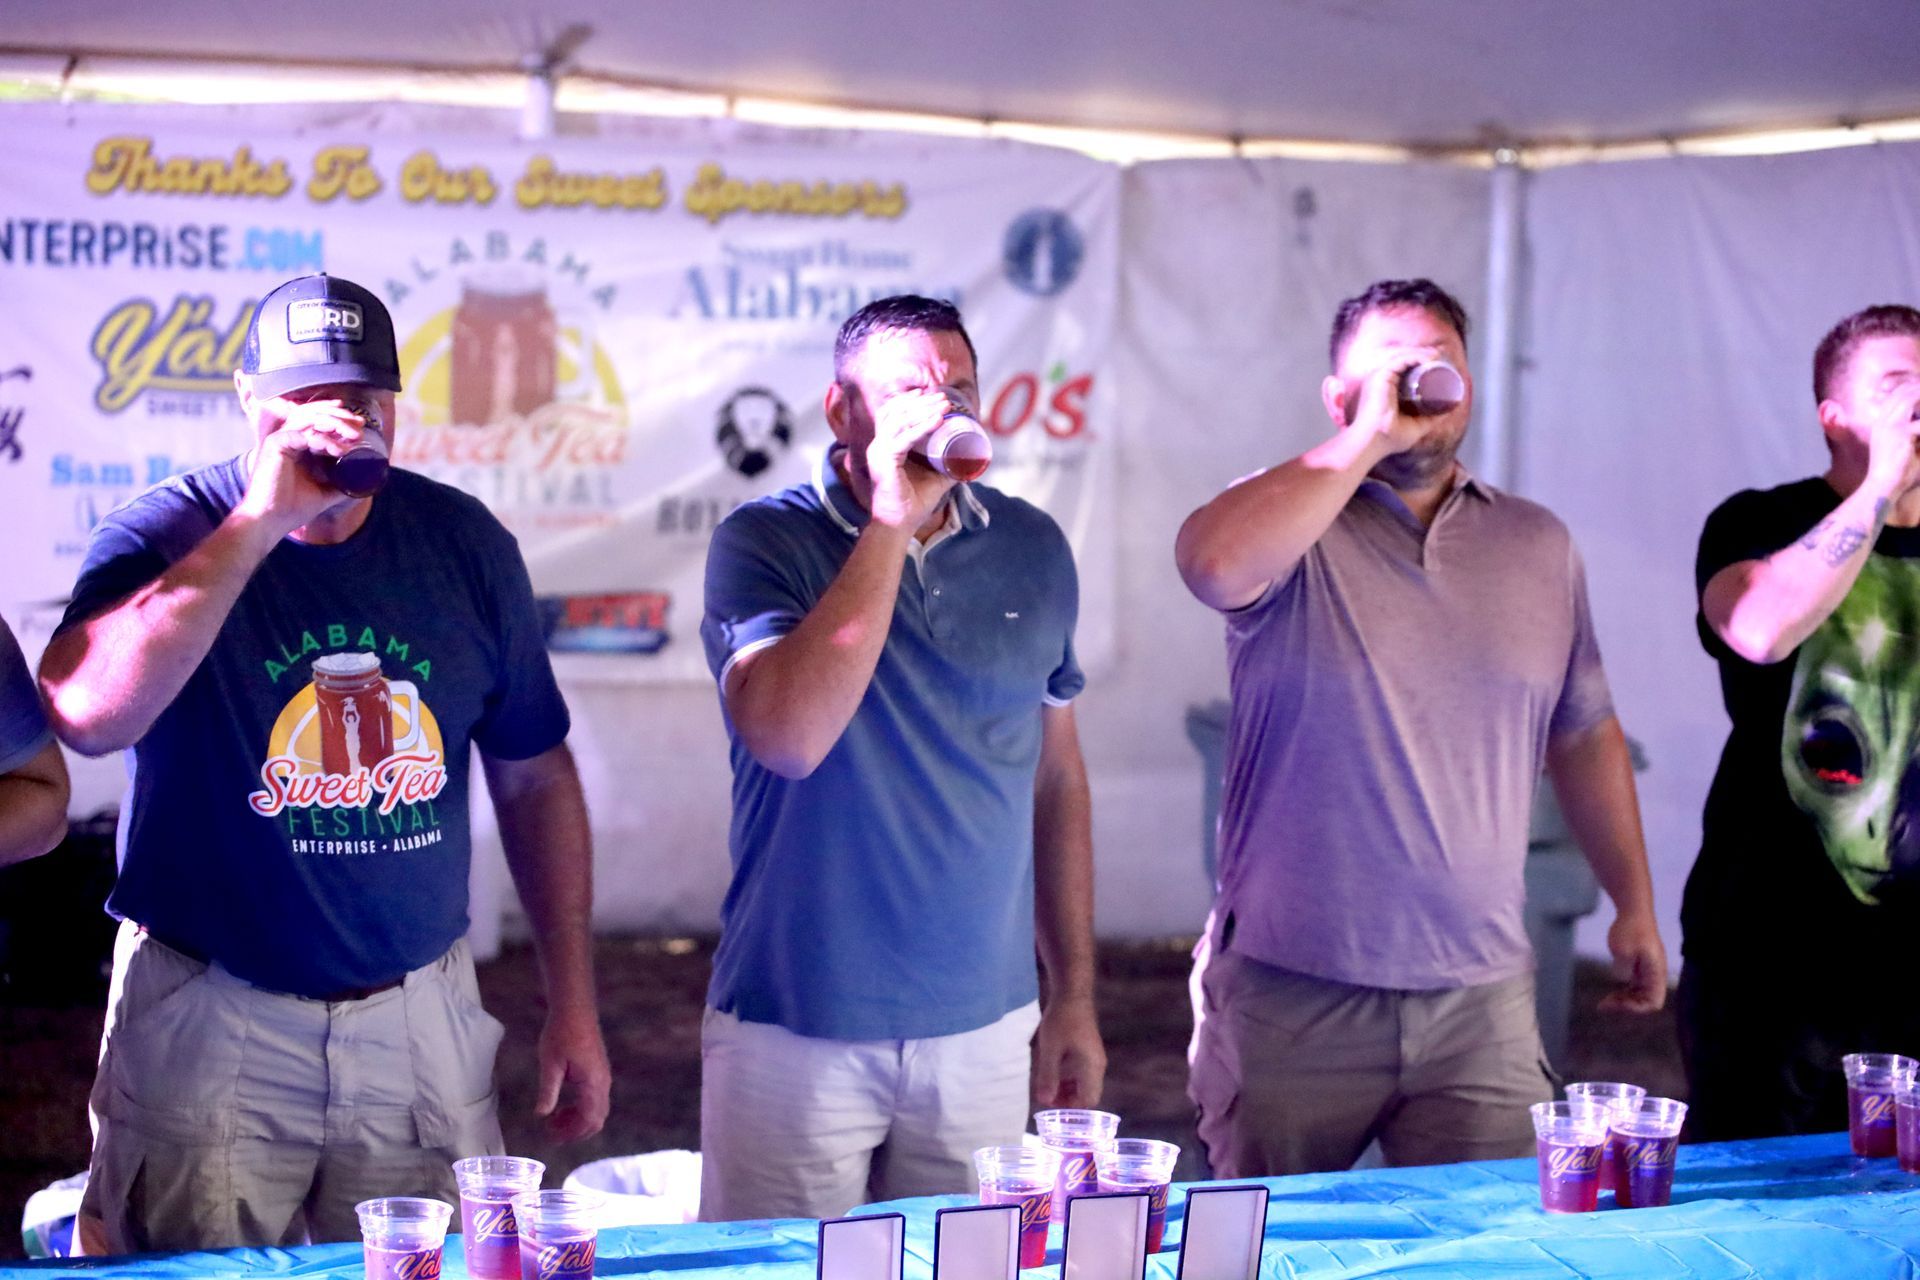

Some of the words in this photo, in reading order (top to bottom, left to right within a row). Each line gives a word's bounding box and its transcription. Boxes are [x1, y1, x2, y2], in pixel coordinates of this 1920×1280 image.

[87, 136, 292, 194] Thanks
[307, 144, 382, 201] To
[402, 149, 496, 204] Our
[516, 154, 669, 210] Sweet
[51, 455, 133, 485] Sam
[264, 624, 432, 683] ALABAMA
[250, 757, 371, 815] Sweet
[374, 752, 446, 814] Tea
[288, 799, 439, 836] FESTIVAL
[292, 838, 376, 855] ENTERPRISE
[393, 829, 442, 852] ALABAMA
